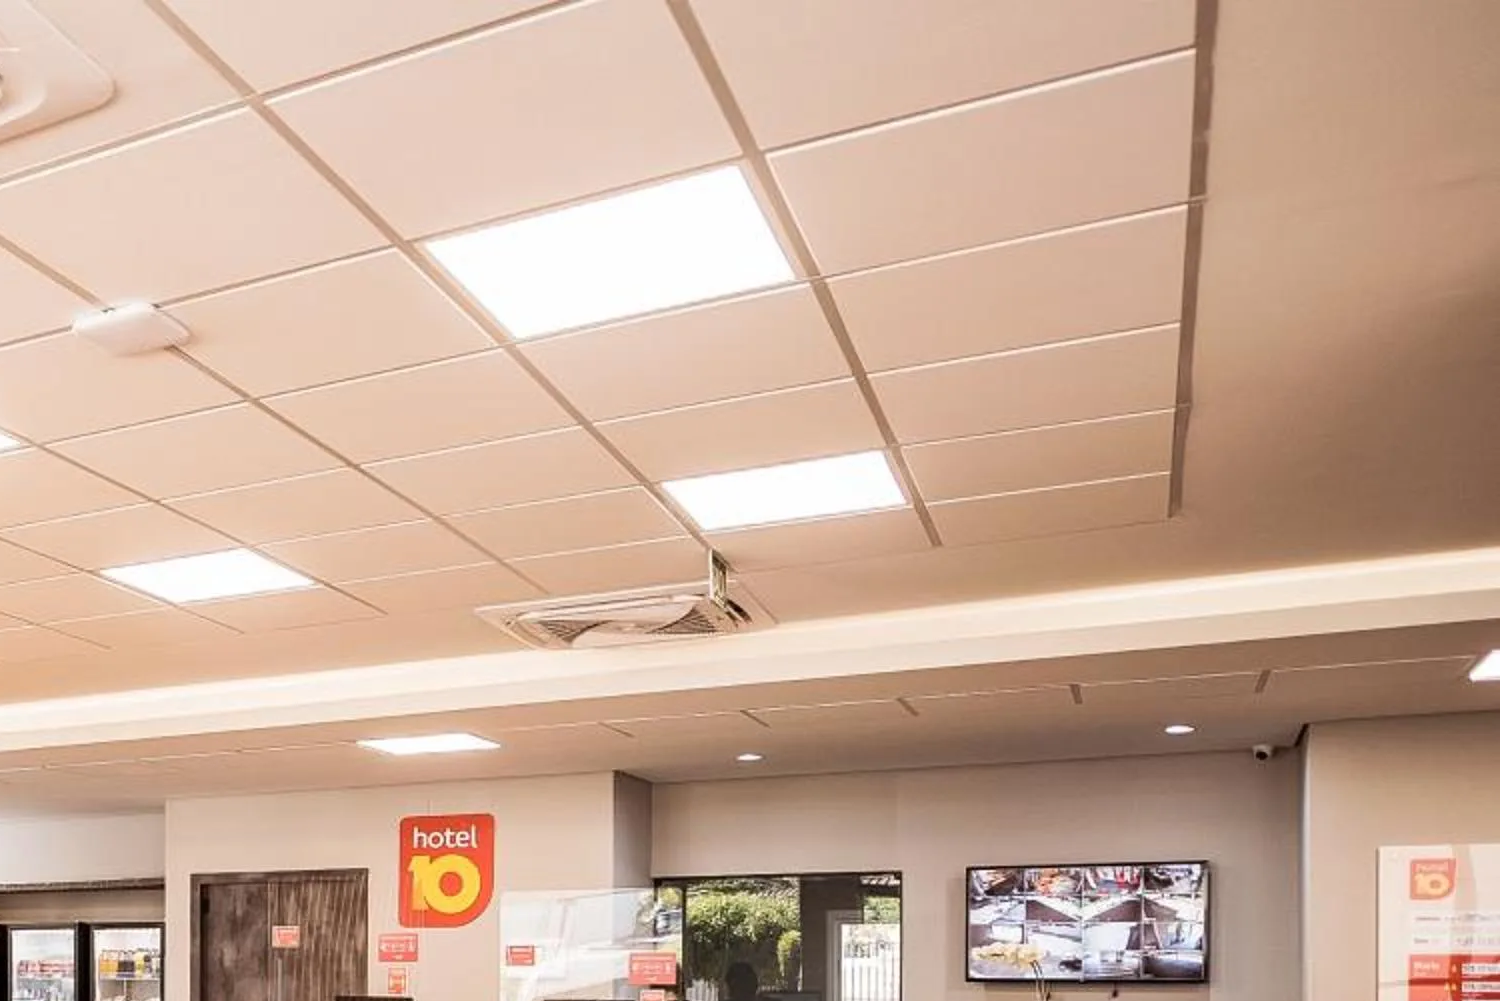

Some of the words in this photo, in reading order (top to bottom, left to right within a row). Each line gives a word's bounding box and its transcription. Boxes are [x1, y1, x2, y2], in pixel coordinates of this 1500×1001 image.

[412, 824, 478, 849] hotel
[407, 853, 481, 915] 10
[1414, 873, 1450, 896] 10
